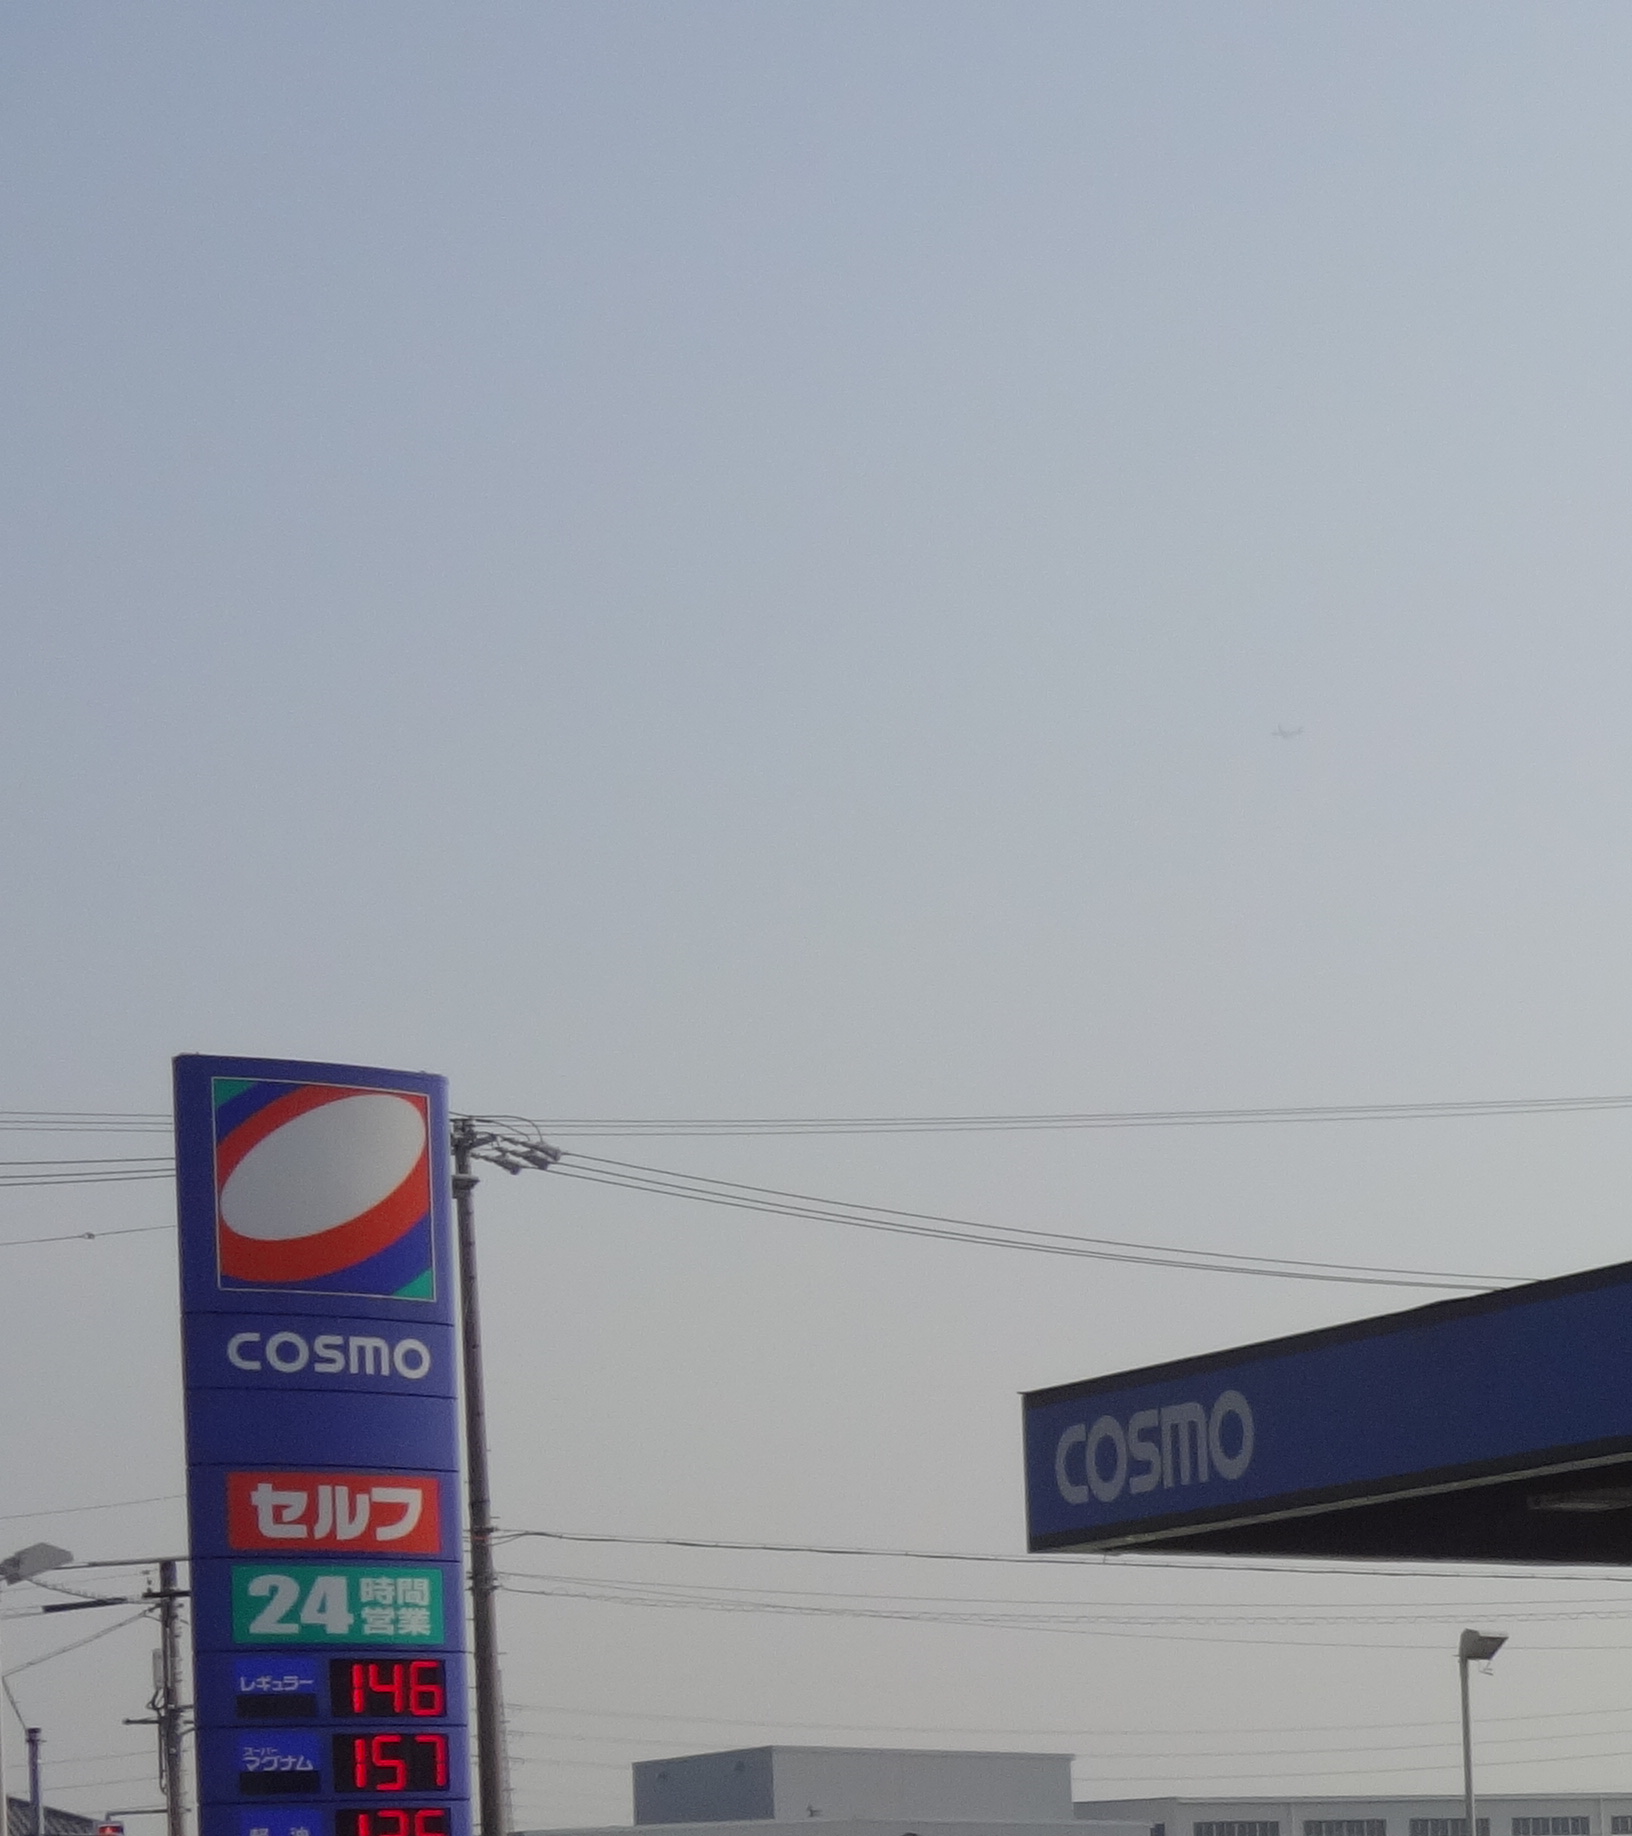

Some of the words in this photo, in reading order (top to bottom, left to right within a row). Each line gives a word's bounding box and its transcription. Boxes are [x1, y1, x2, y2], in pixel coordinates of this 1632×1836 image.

[227, 1332, 431, 1379] COSMO
[1055, 1389, 1254, 1505] COSMO
[251, 1482, 422, 1541] セルフ
[248, 1574, 354, 1635] 24
[360, 1577, 430, 1605] 時間
[360, 1606, 431, 1636] 営業
[240, 1676, 313, 1692] レギュラー
[352, 1660, 444, 1716] 146
[243, 1754, 314, 1771] マグナム
[355, 1735, 447, 1791] 157
